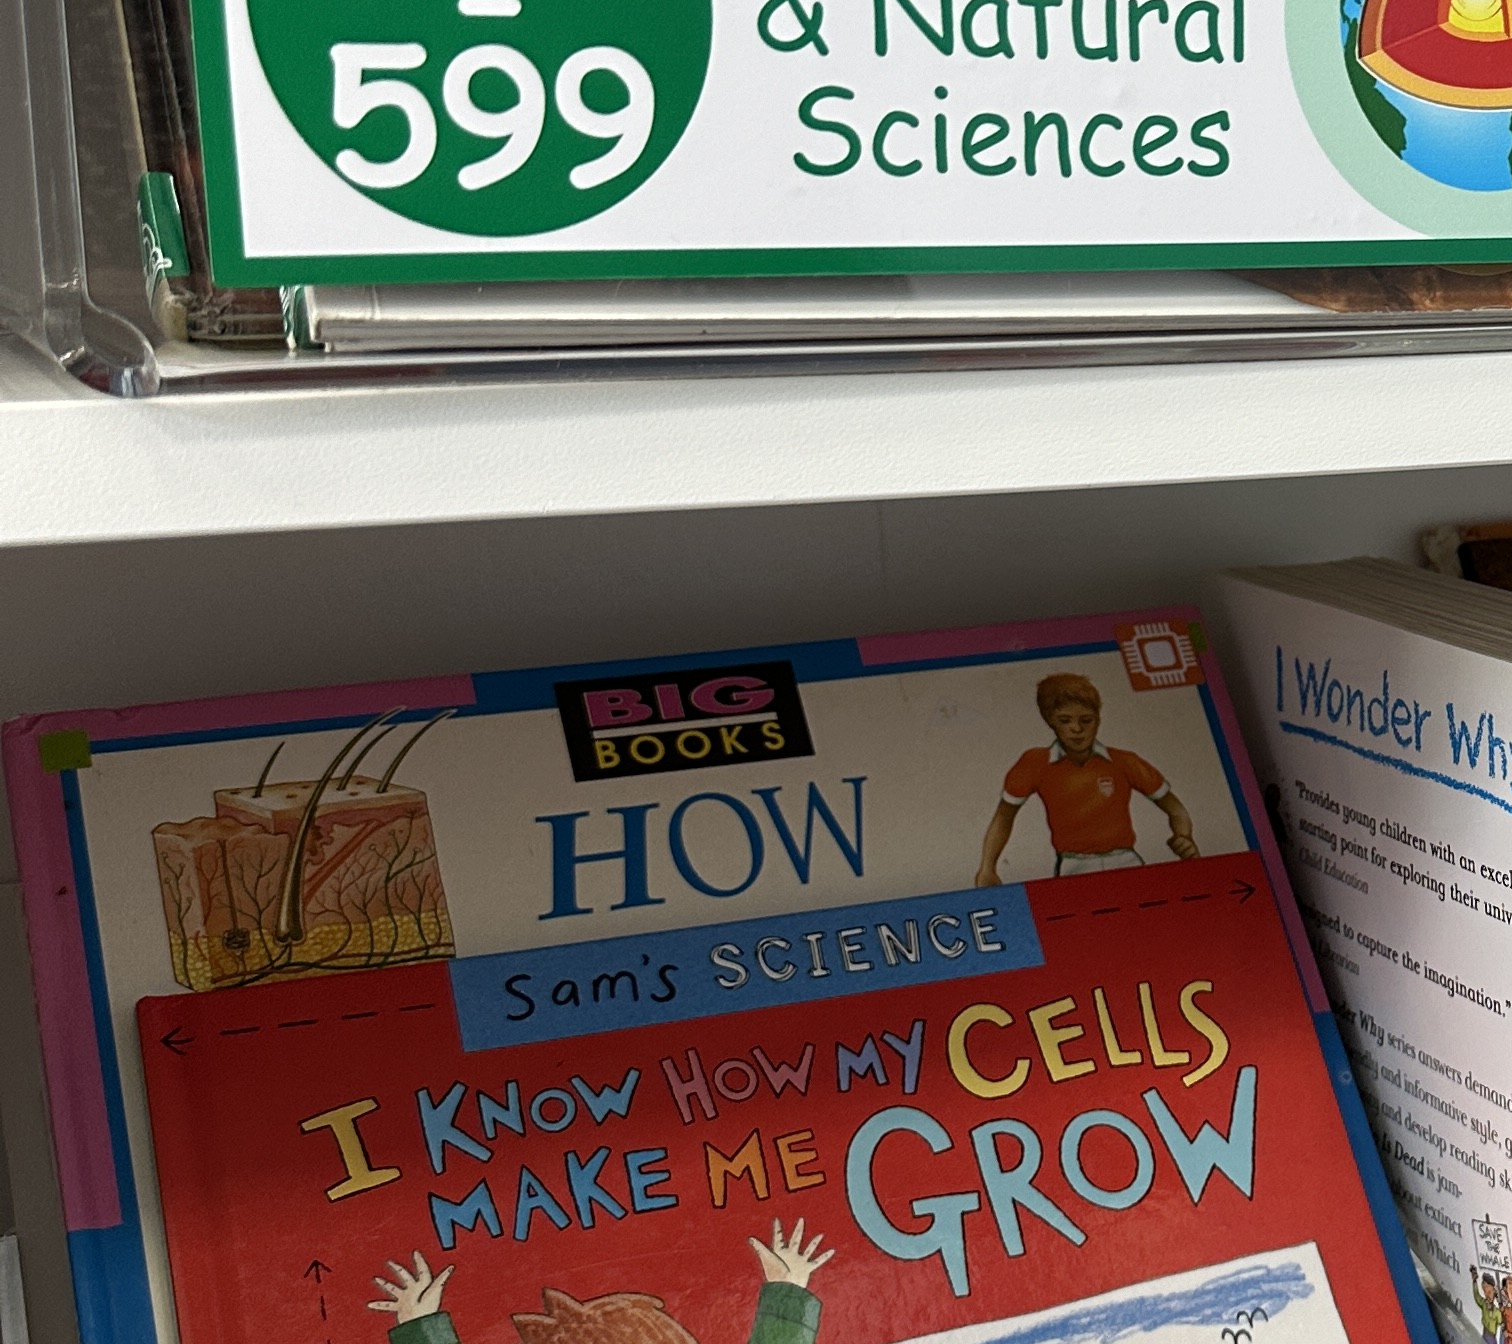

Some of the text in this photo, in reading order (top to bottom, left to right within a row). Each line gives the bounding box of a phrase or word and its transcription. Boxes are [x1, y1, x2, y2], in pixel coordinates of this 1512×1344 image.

[331, 41, 655, 192] 599
[793, 85, 1230, 180] Sciences
[584, 676, 776, 727] BIG
[1276, 645, 1284, 712] I
[1296, 658, 1431, 752] Wonder
[595, 722, 786, 769] BOOKS
[534, 776, 868, 921] HOW
[1343, 803, 1376, 836] young
[1380, 816, 1427, 853] children
[1430, 842, 1455, 865] with
[1460, 856, 1475, 872] an
[1341, 836, 1368, 864] point
[1371, 848, 1386, 869] for
[1391, 859, 1446, 901] exploring
[1450, 885, 1480, 912] their
[505, 909, 1005, 1023] Sam's SCIENCE
[1357, 929, 1399, 964] capture
[1402, 953, 1420, 974] the
[299, 980, 1230, 1203] I KNOW HOW MY CELLS
[1418, 1046, 1462, 1084] answers
[1450, 1142, 1496, 1188] reading
[1471, 1116, 1501, 1149] style,
[428, 1066, 1256, 1298] MAKE ME GROW
[1478, 1224, 1503, 1243] SAVE
